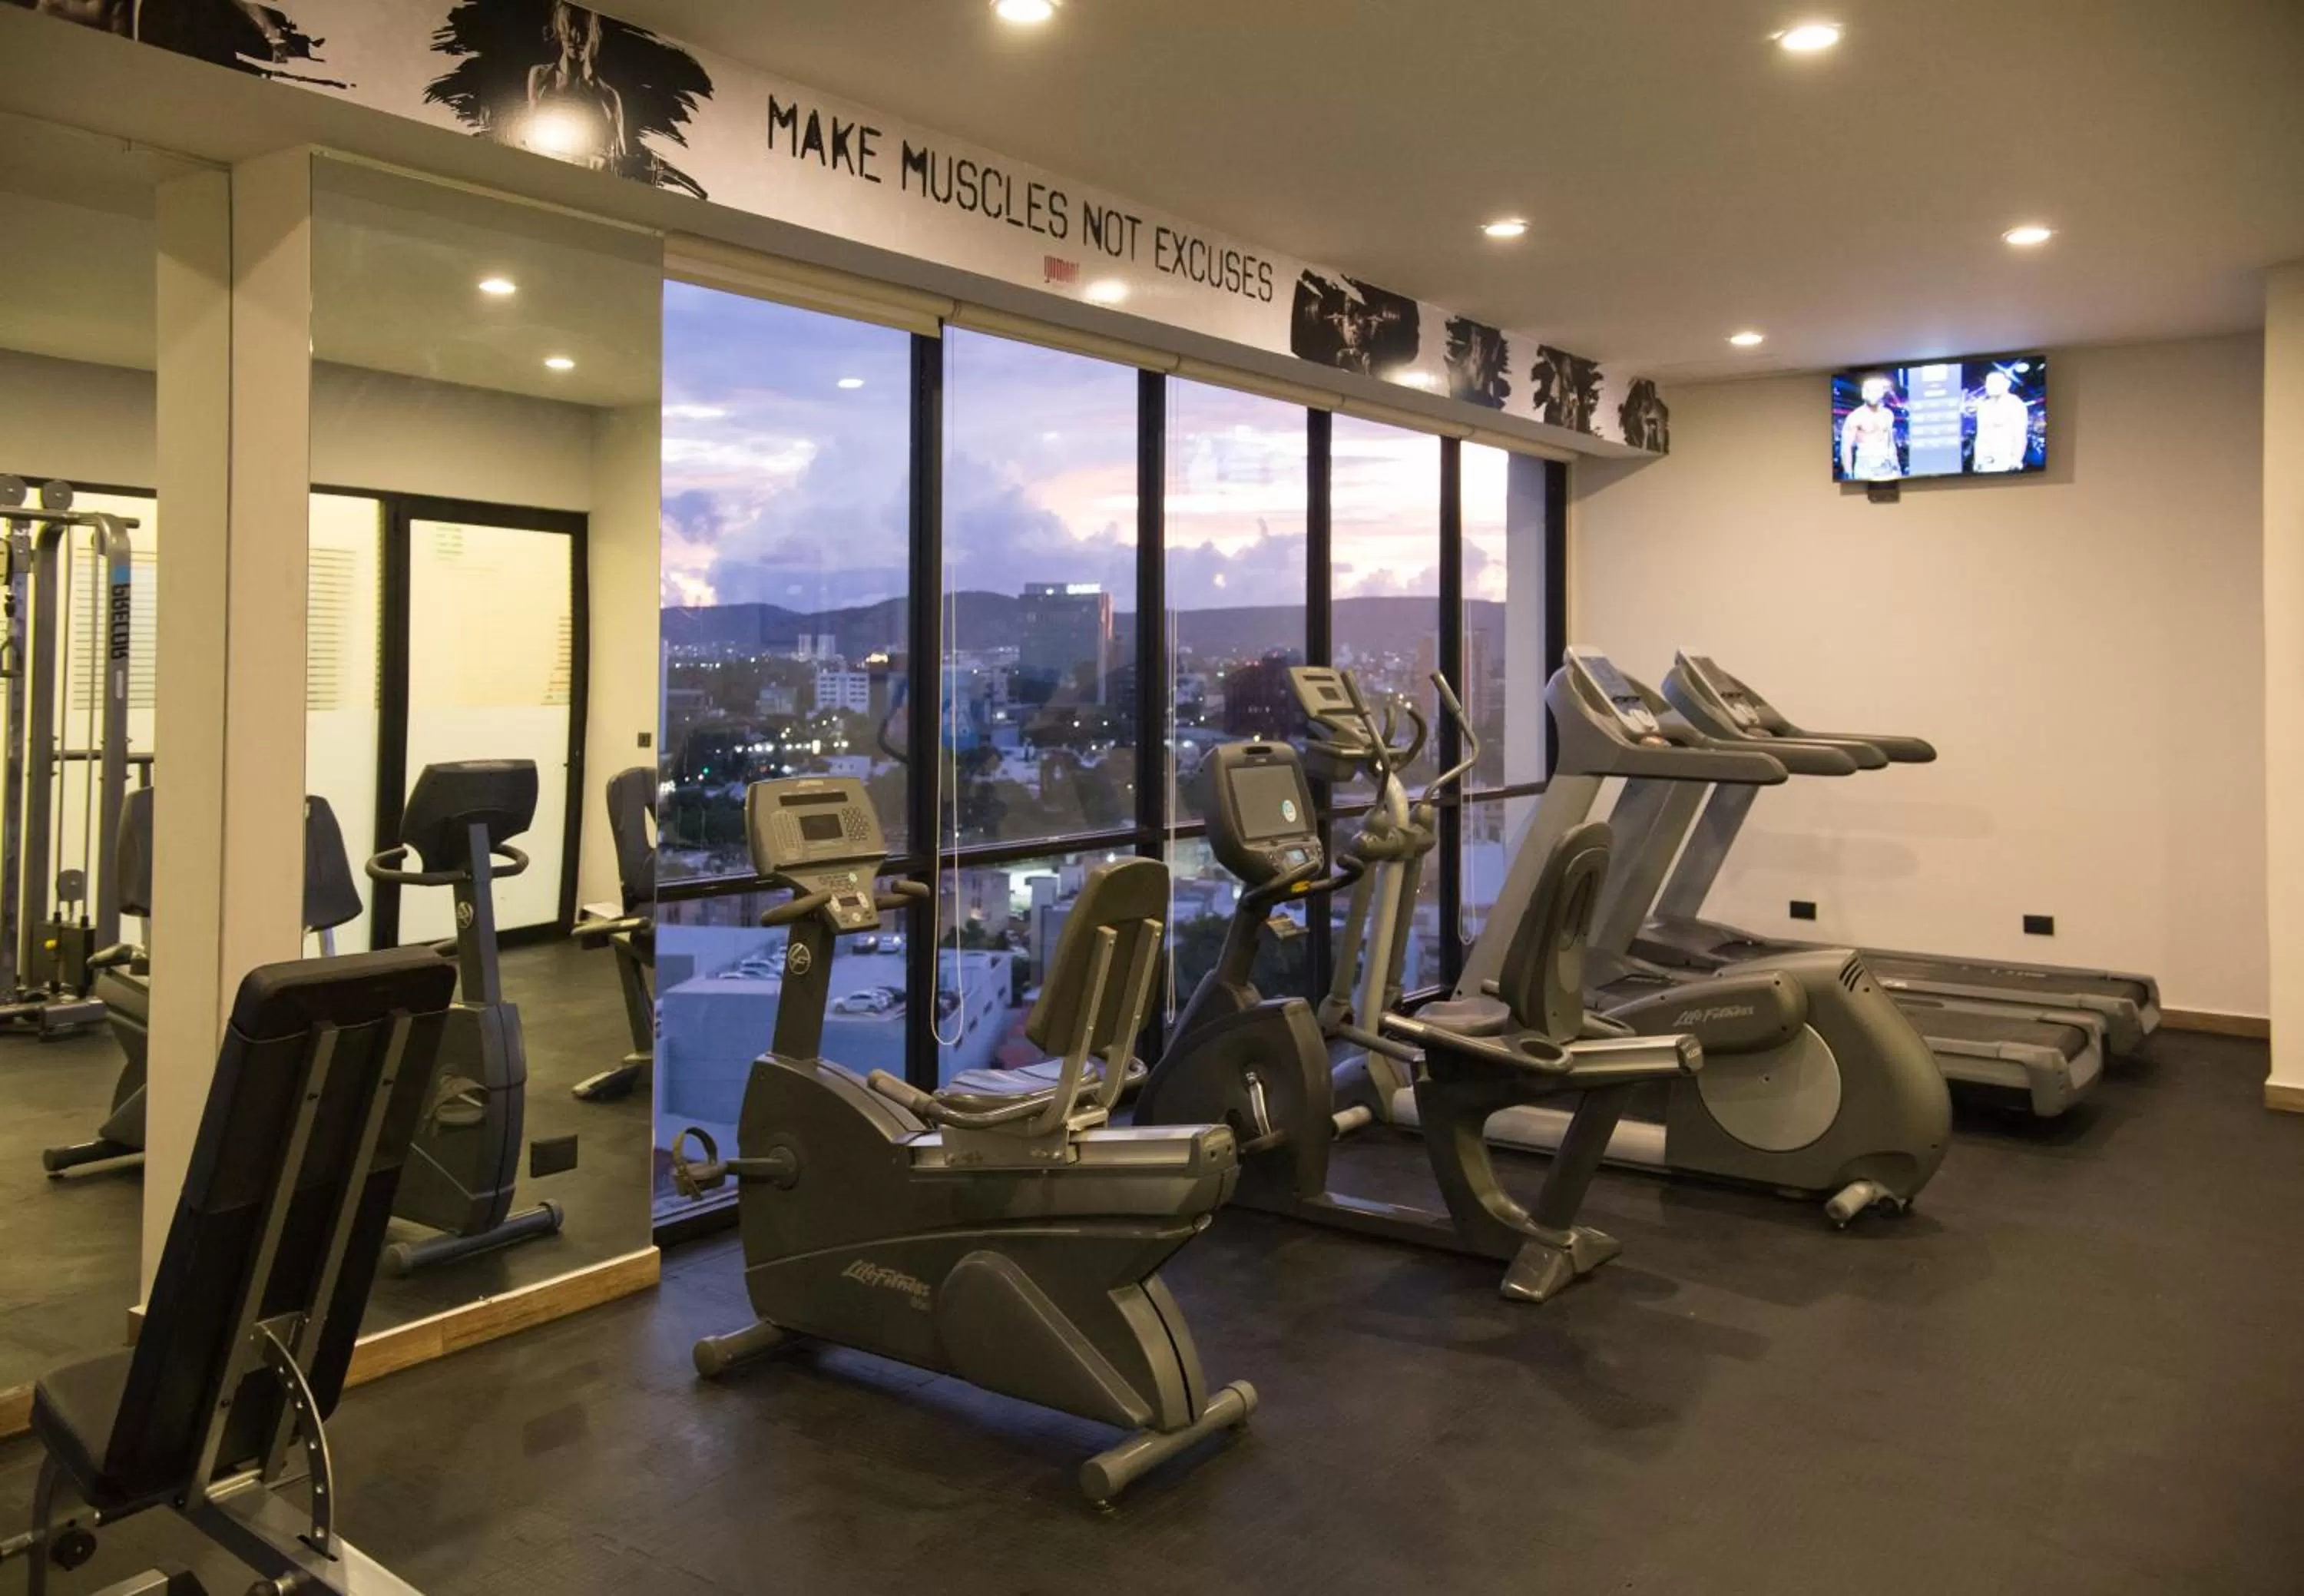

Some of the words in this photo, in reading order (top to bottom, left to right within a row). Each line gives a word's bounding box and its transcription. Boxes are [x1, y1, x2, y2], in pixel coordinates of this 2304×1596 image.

[768, 93, 882, 184] MAKE
[902, 139, 1068, 239] MUSCLES
[1082, 200, 1143, 262] NOT
[1154, 225, 1274, 303] EXCUSES
